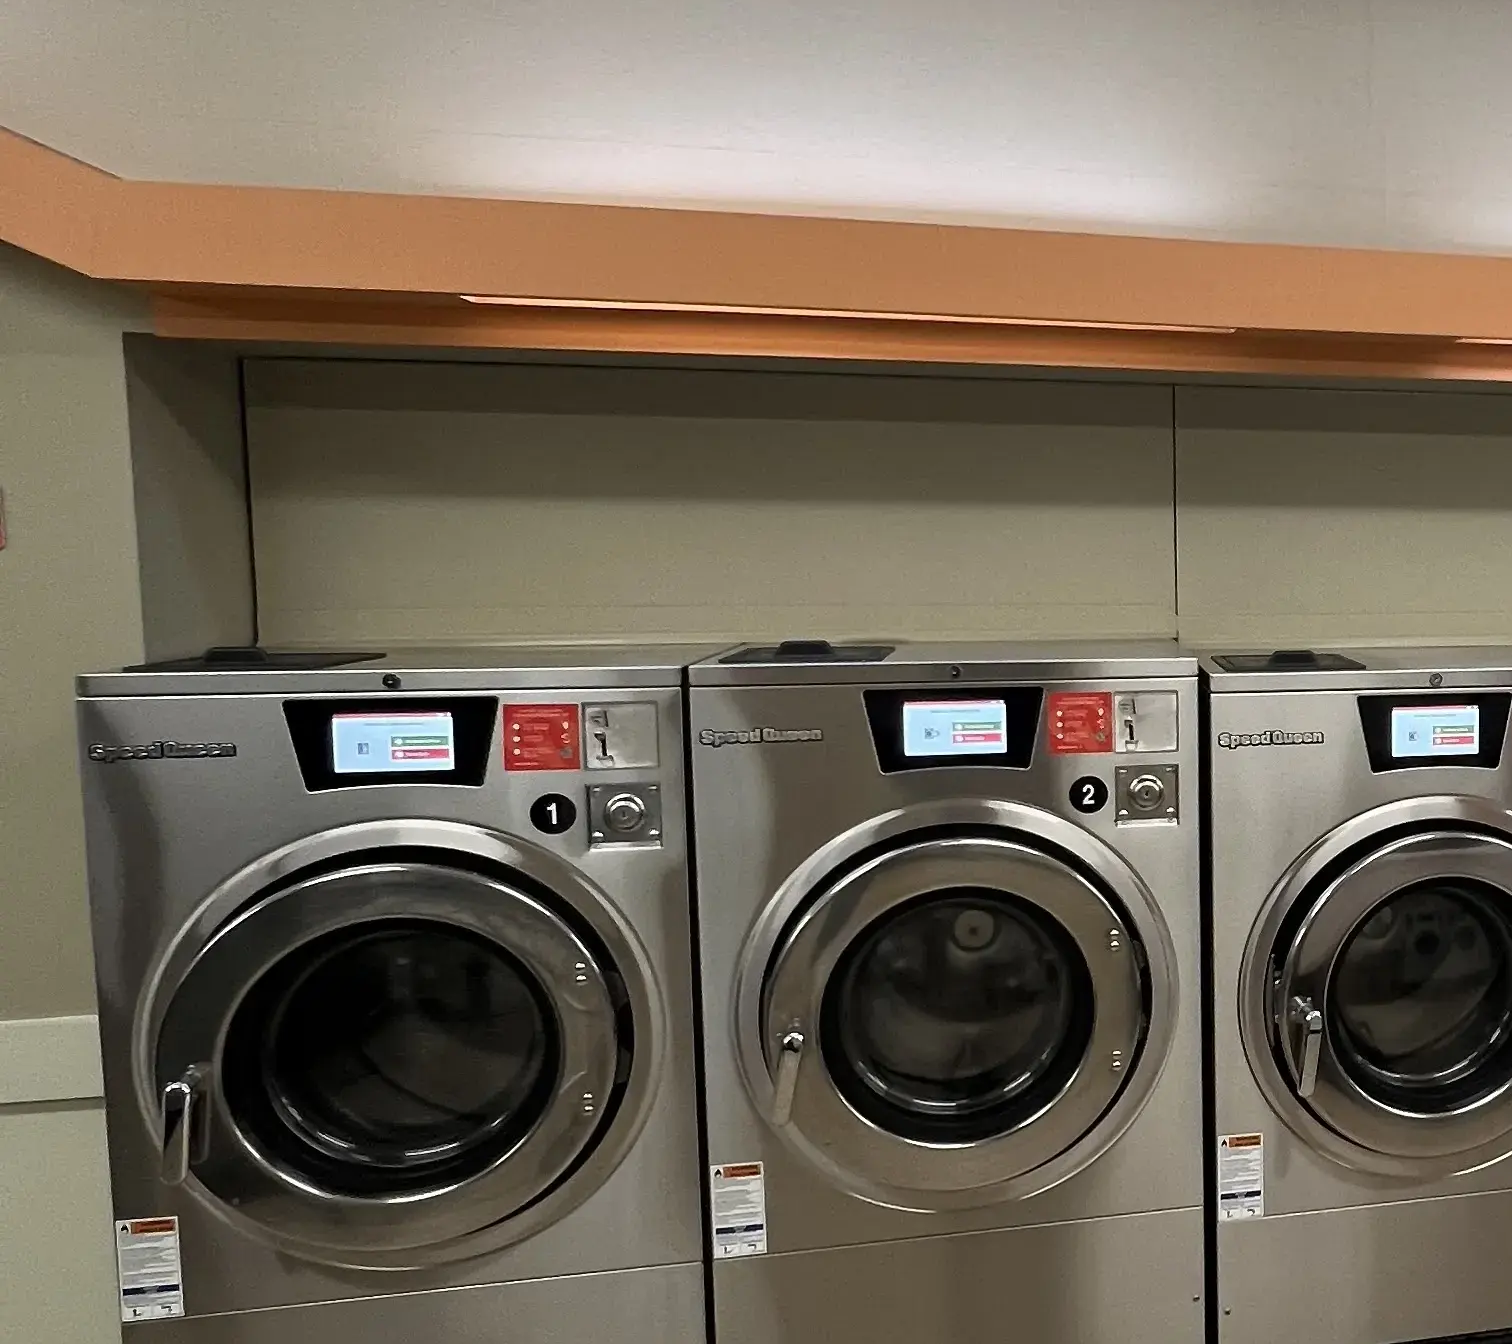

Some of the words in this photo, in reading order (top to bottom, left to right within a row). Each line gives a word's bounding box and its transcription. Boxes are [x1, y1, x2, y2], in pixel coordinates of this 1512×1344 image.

[699, 728, 762, 748] Speed
[1217, 730, 1272, 750] Speed
[1272, 729, 1325, 745] Queen
[88, 739, 163, 764] Speed
[1082, 784, 1095, 805] 2
[546, 802, 558, 825] 1
